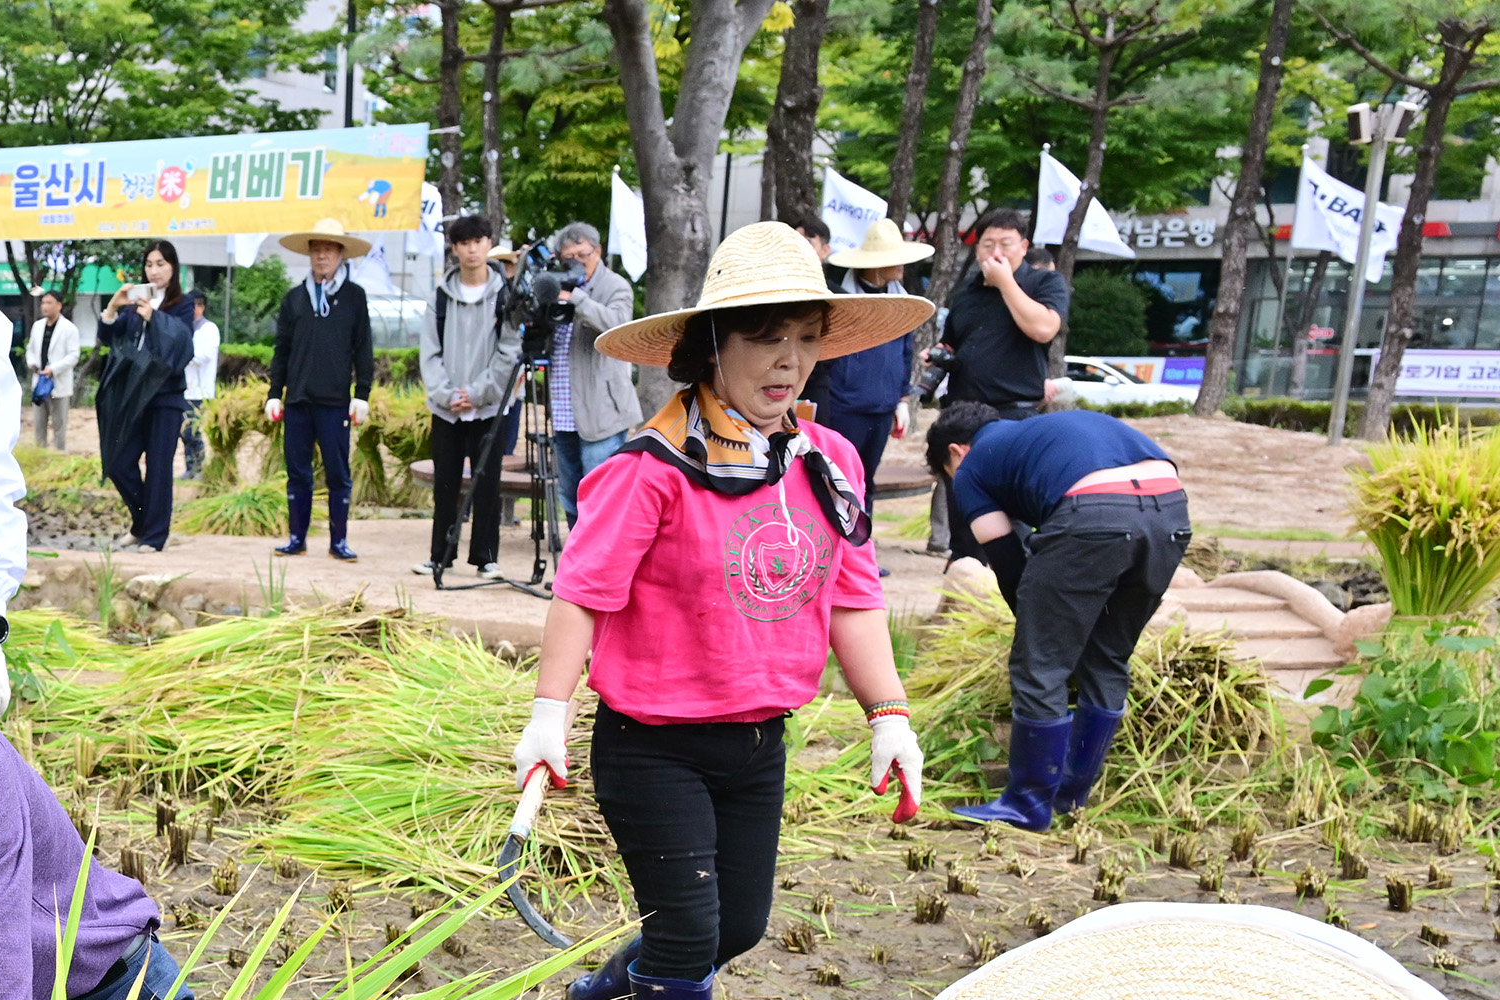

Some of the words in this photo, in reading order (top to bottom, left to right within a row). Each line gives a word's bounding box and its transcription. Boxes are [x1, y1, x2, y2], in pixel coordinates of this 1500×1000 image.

[13, 160, 106, 209] 울산시
[208, 148, 325, 200] 벼베기
[1401, 364, 1461, 380] 토기업
